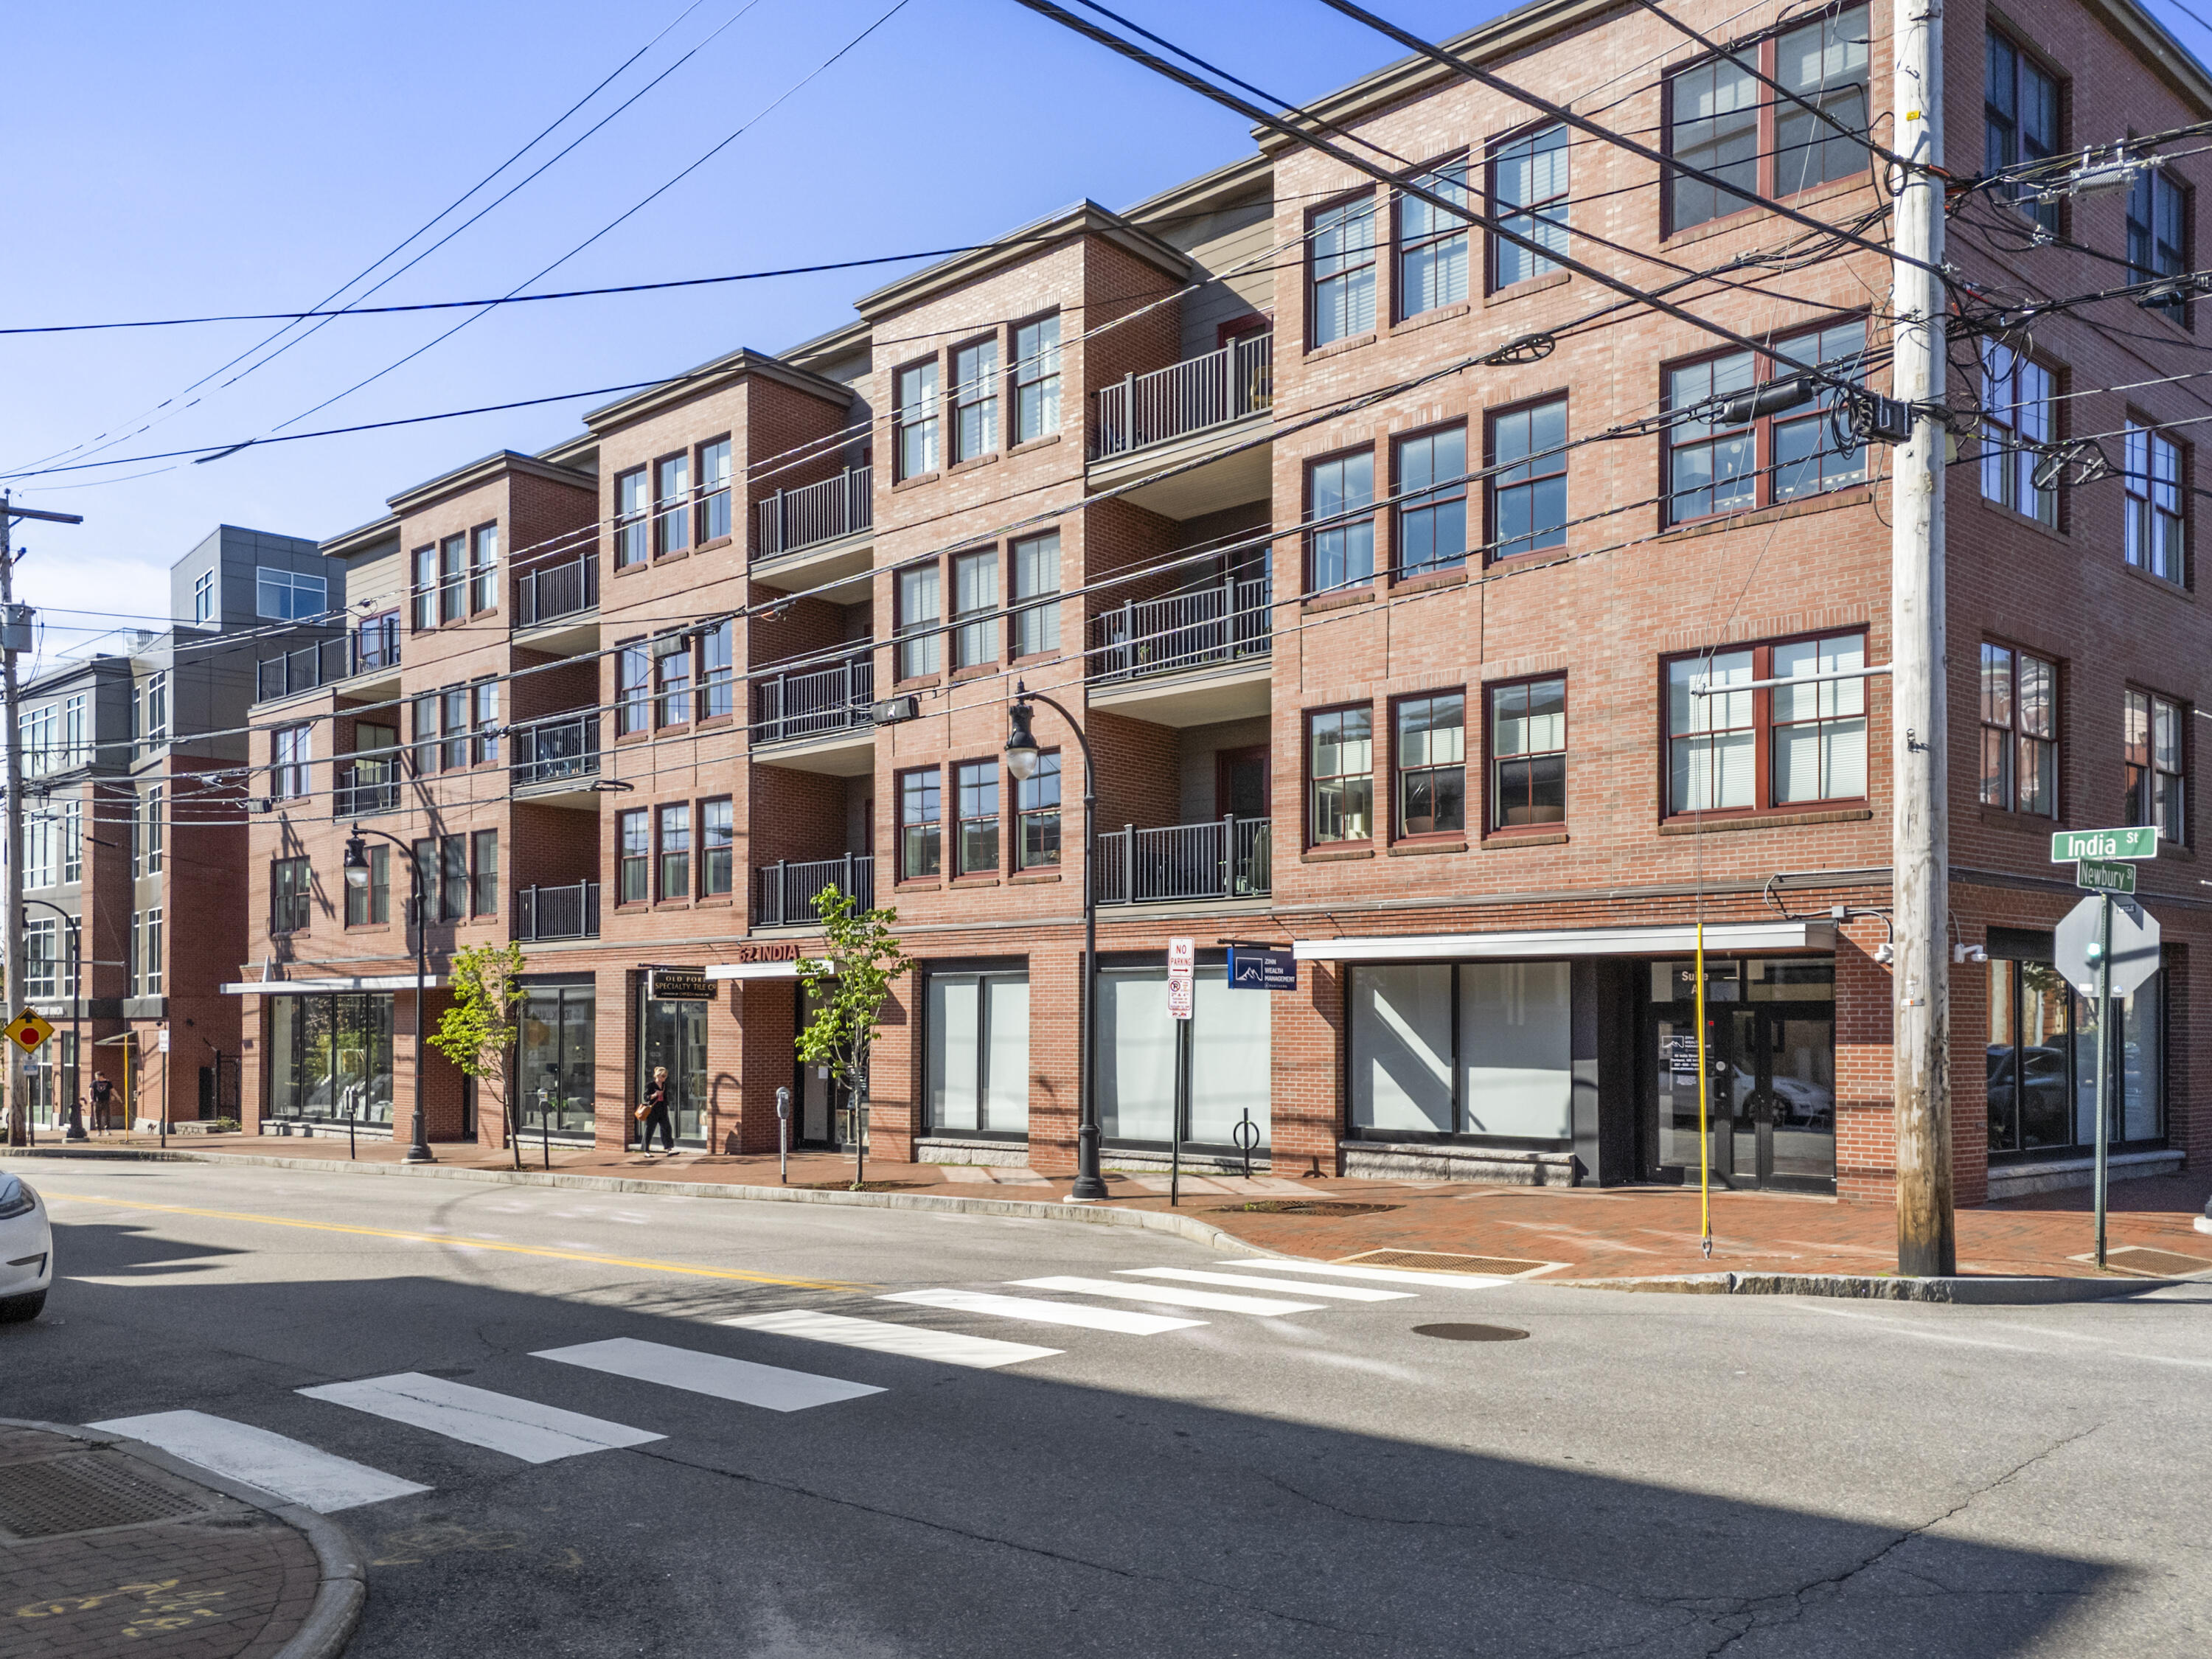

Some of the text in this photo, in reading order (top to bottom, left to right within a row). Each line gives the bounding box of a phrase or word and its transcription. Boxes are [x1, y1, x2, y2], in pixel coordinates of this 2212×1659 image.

[2067, 832, 2139, 857] India St
[2081, 862, 2133, 889] Newbury St
[739, 945, 799, 962] 62 INDIA
[1176, 945, 1187, 954] NO
[1171, 957, 1192, 967] PARKING
[1681, 970, 1709, 981] Suie
[655, 982, 691, 990] SPECIALTY
